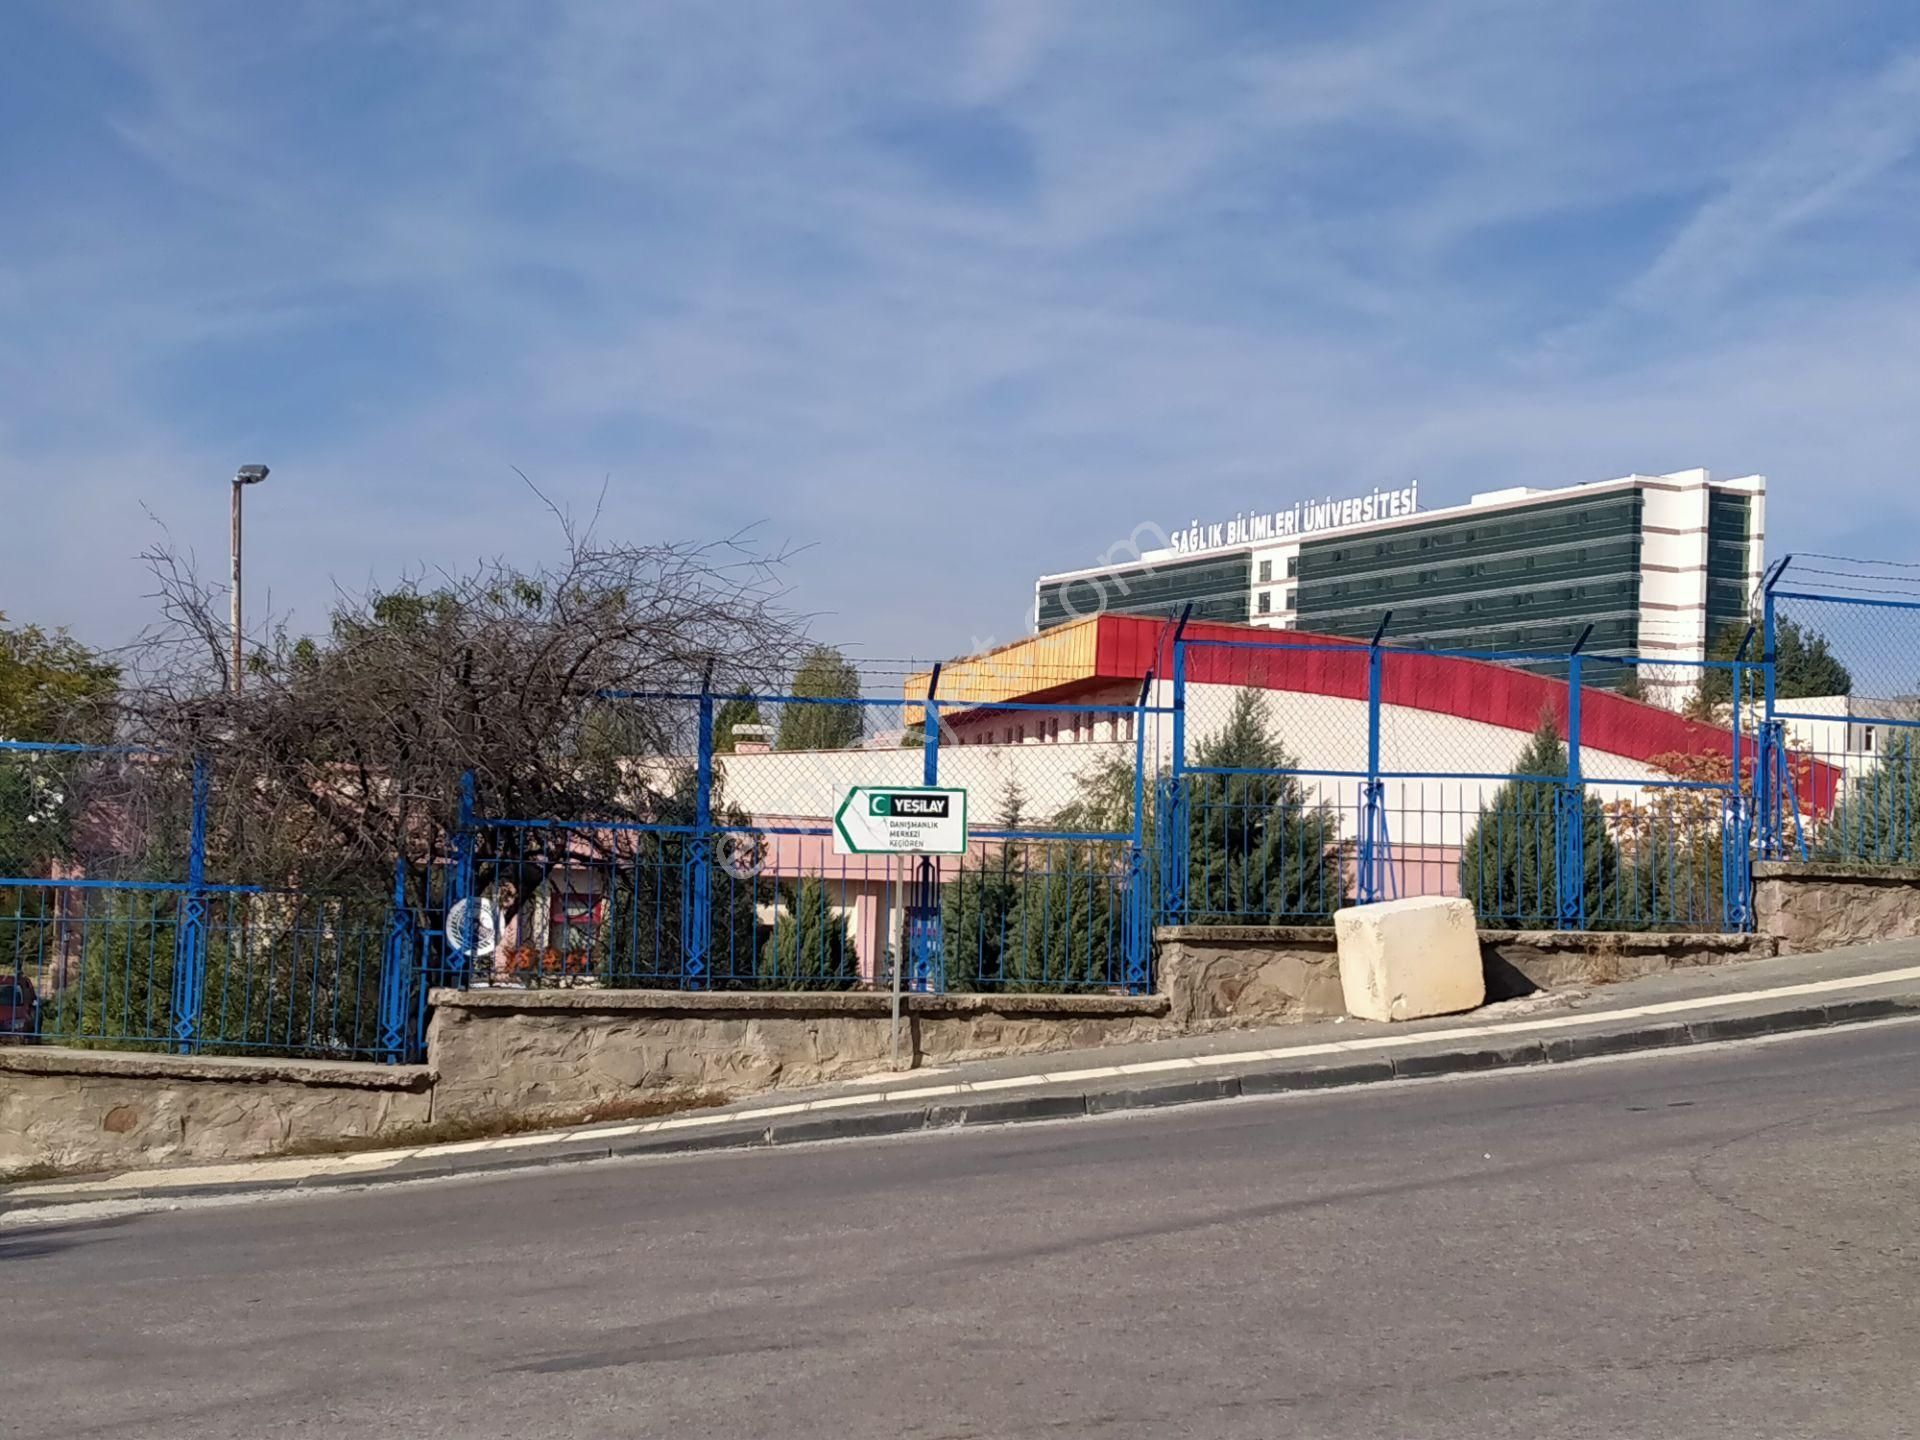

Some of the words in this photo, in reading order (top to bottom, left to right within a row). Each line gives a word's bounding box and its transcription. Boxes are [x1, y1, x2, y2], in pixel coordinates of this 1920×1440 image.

[1171, 520, 1223, 553] SAĞLIK
[1227, 503, 1300, 545] BİLİMLERİ
[1304, 480, 1418, 532] ÜNİVERSİTESİ
